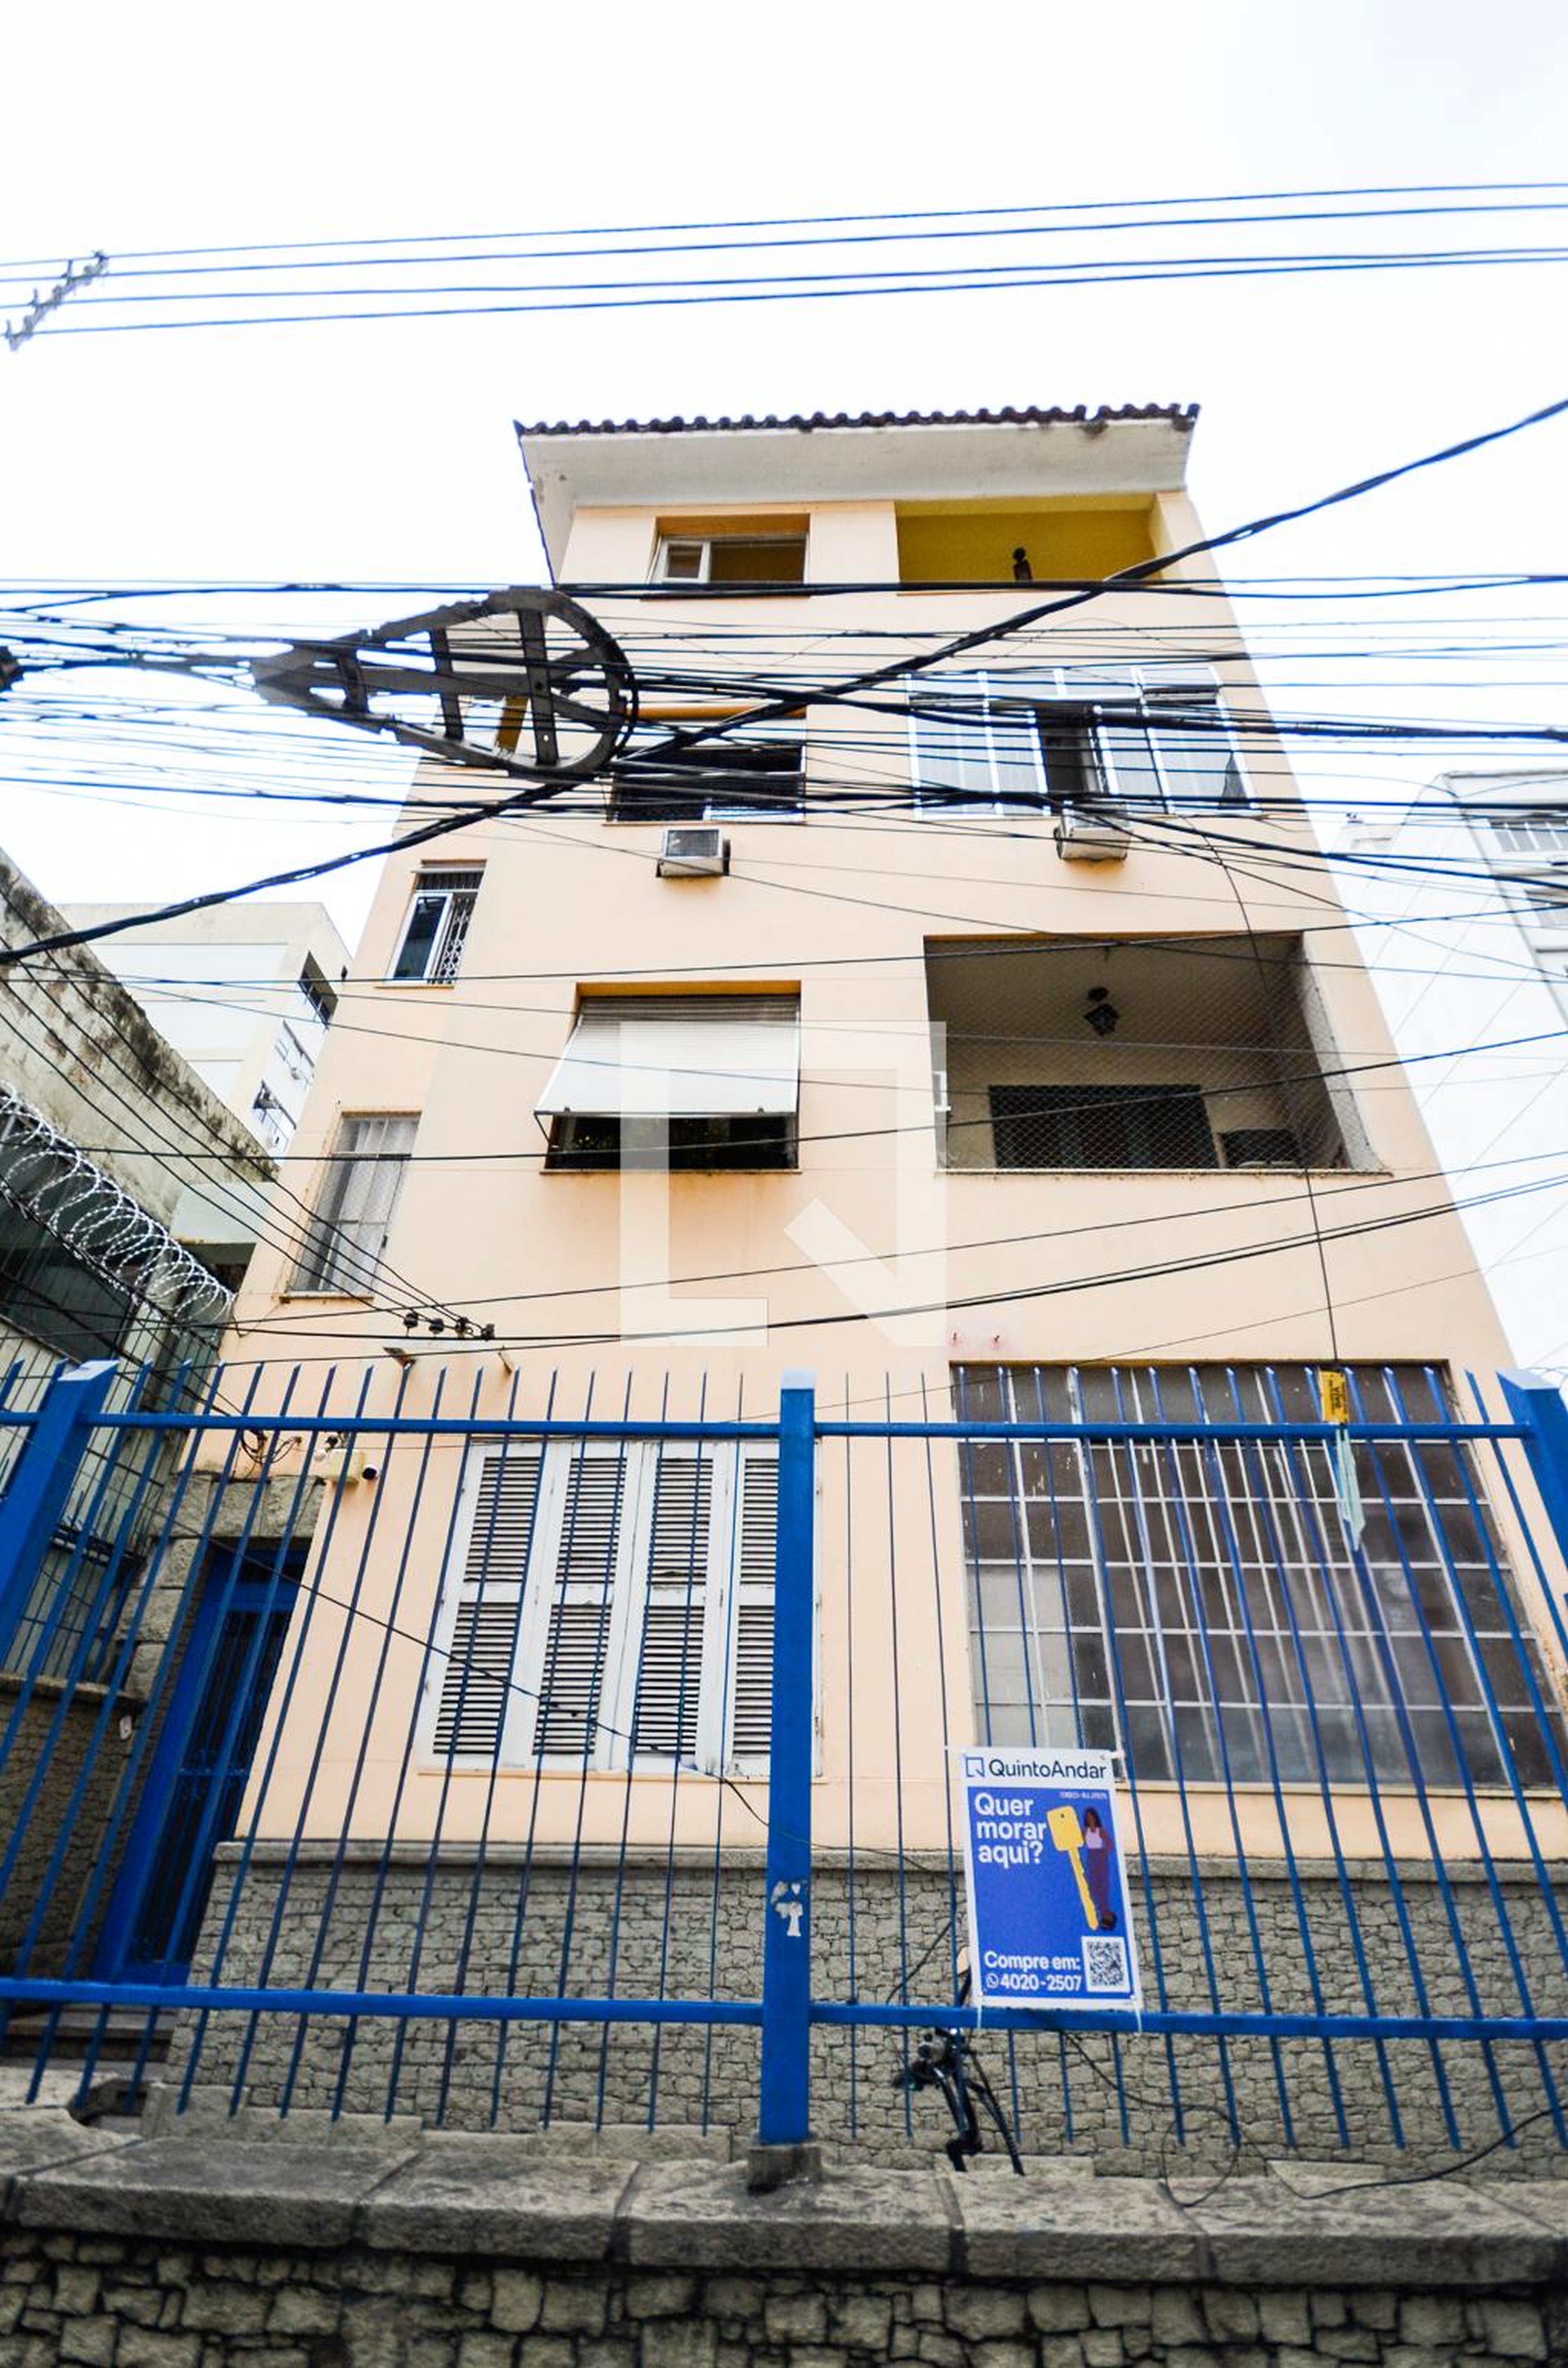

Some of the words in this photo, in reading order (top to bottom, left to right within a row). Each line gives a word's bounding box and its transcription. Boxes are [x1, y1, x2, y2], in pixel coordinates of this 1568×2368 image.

[989, 1759, 1107, 1778] QuintoAndar
[975, 1793, 1033, 1816] Quer
[977, 1821, 1046, 1839] morar
[978, 1841, 1043, 1869] aqui?
[984, 1951, 1049, 1972] Compre
[1052, 1957, 1081, 1970] em:
[1000, 1974, 1082, 1991] 4020-2507
